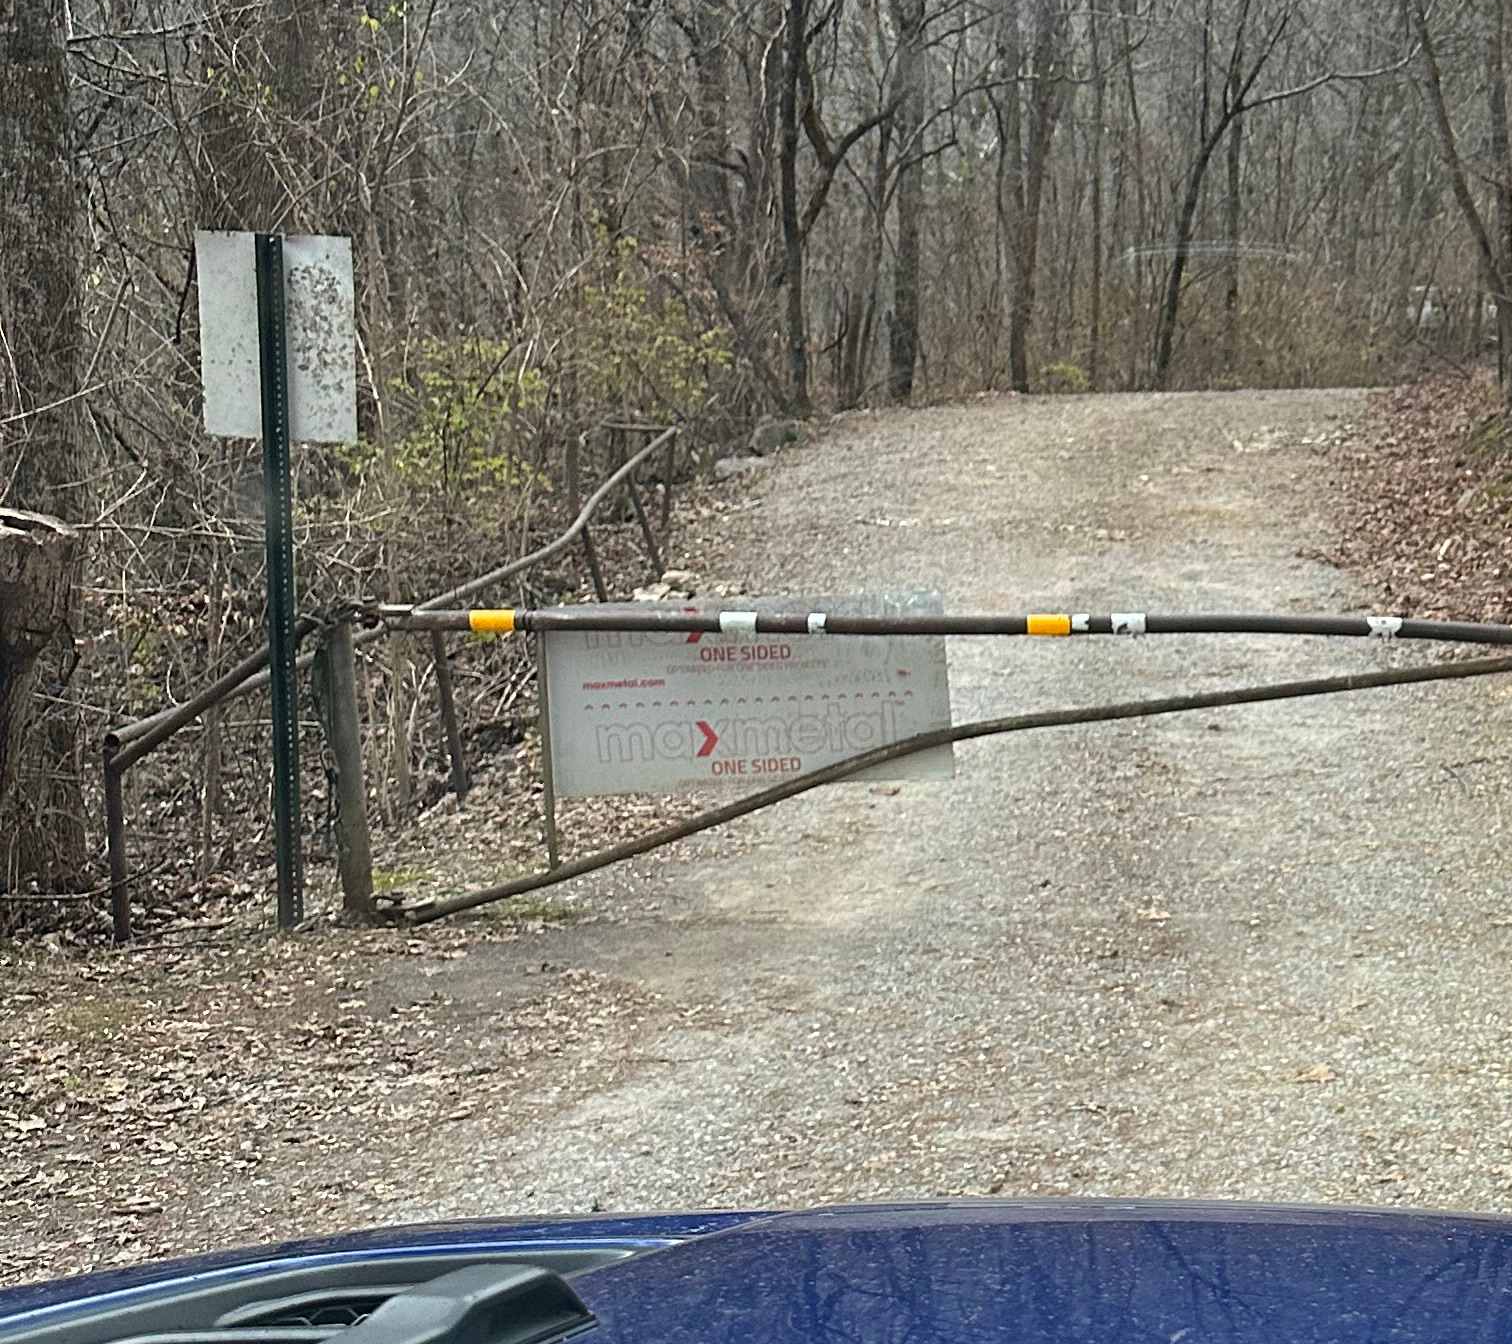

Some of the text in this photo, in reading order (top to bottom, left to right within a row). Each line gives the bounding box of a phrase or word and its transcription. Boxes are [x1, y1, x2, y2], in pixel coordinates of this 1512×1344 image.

[700, 644, 792, 662] ONE SIDED
[582, 677, 666, 691] maxmetal.com
[595, 700, 897, 763] maxmetal
[711, 757, 801, 775] ONE SIDED
